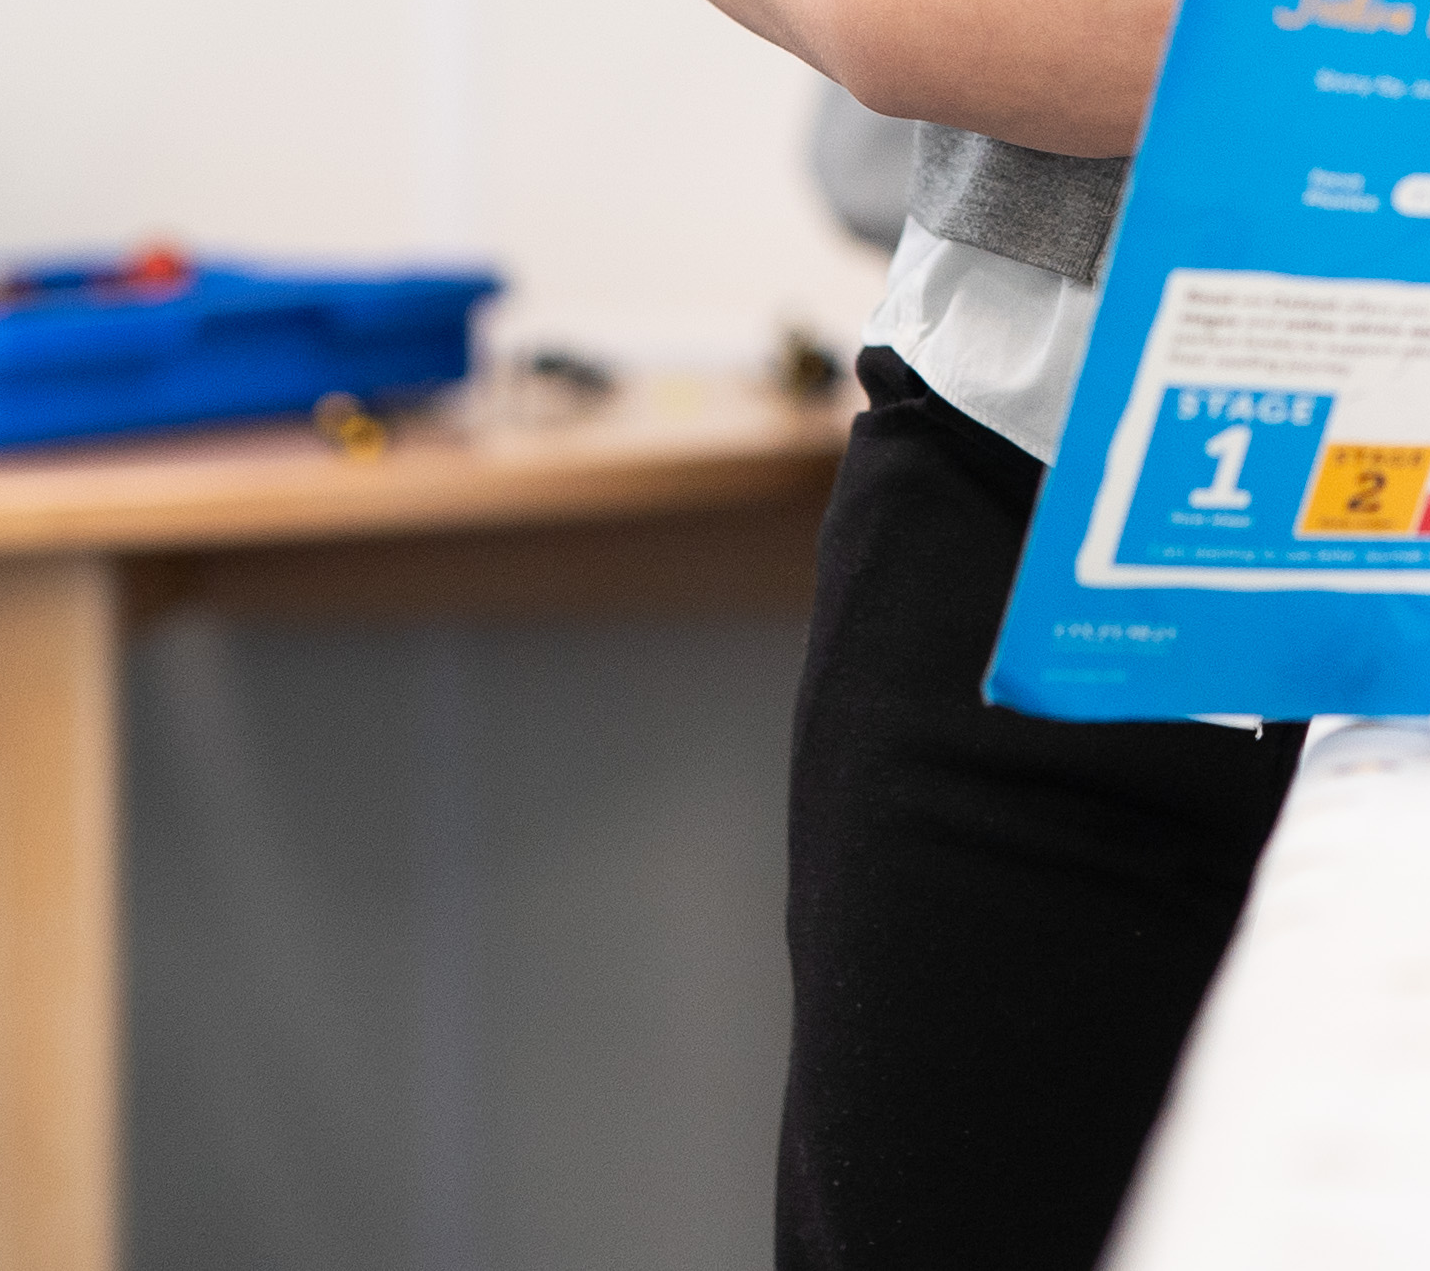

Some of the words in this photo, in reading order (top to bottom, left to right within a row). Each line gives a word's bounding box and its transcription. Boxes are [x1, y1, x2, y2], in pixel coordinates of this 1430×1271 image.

[1176, 392, 1317, 426] STAGE
[1188, 423, 1253, 510] 1
[1345, 470, 1388, 515] 2
